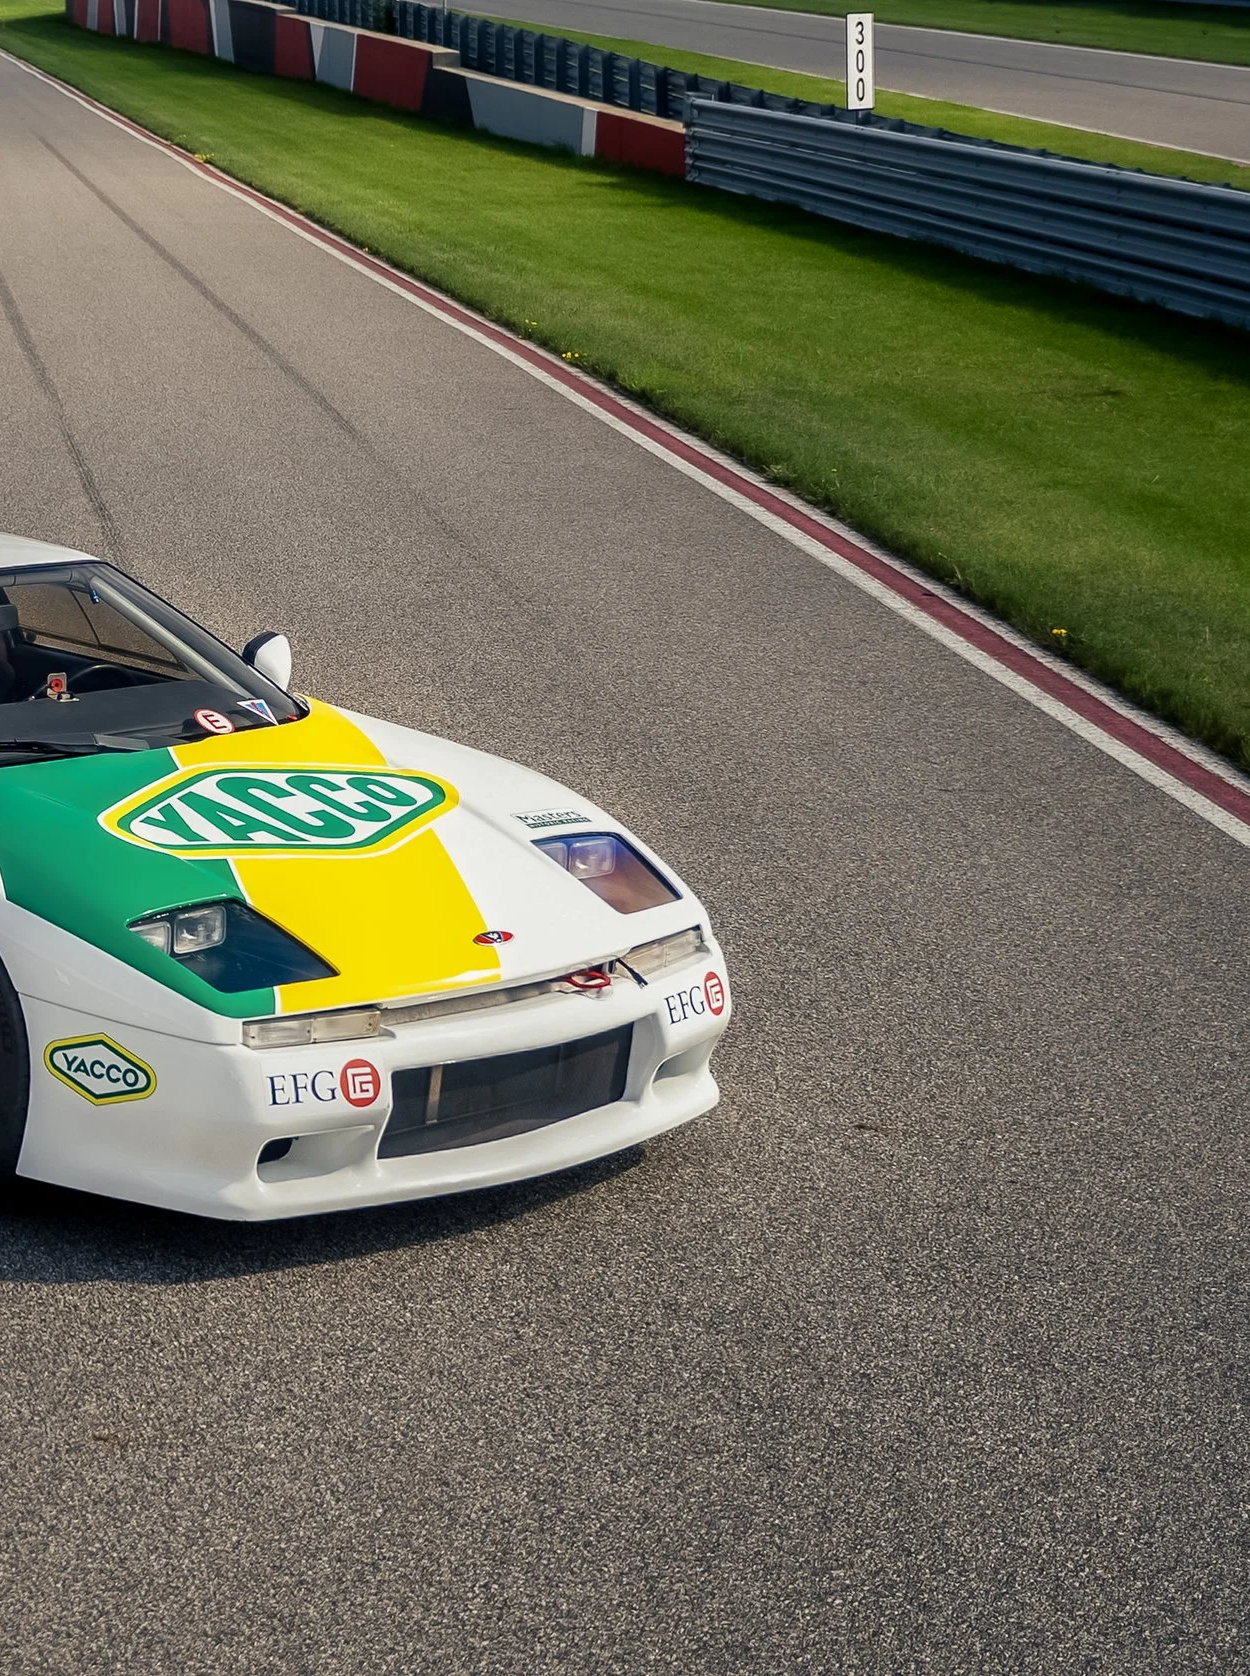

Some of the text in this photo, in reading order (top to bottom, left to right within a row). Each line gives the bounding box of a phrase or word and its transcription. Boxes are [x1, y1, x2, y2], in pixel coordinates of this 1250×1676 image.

[855, 21, 865, 102] 300
[139, 775, 418, 842] YACCO
[516, 811, 582, 823] Masters
[664, 986, 706, 1026] EFG
[62, 1052, 140, 1088] YACCO
[266, 1070, 337, 1106] EFG
